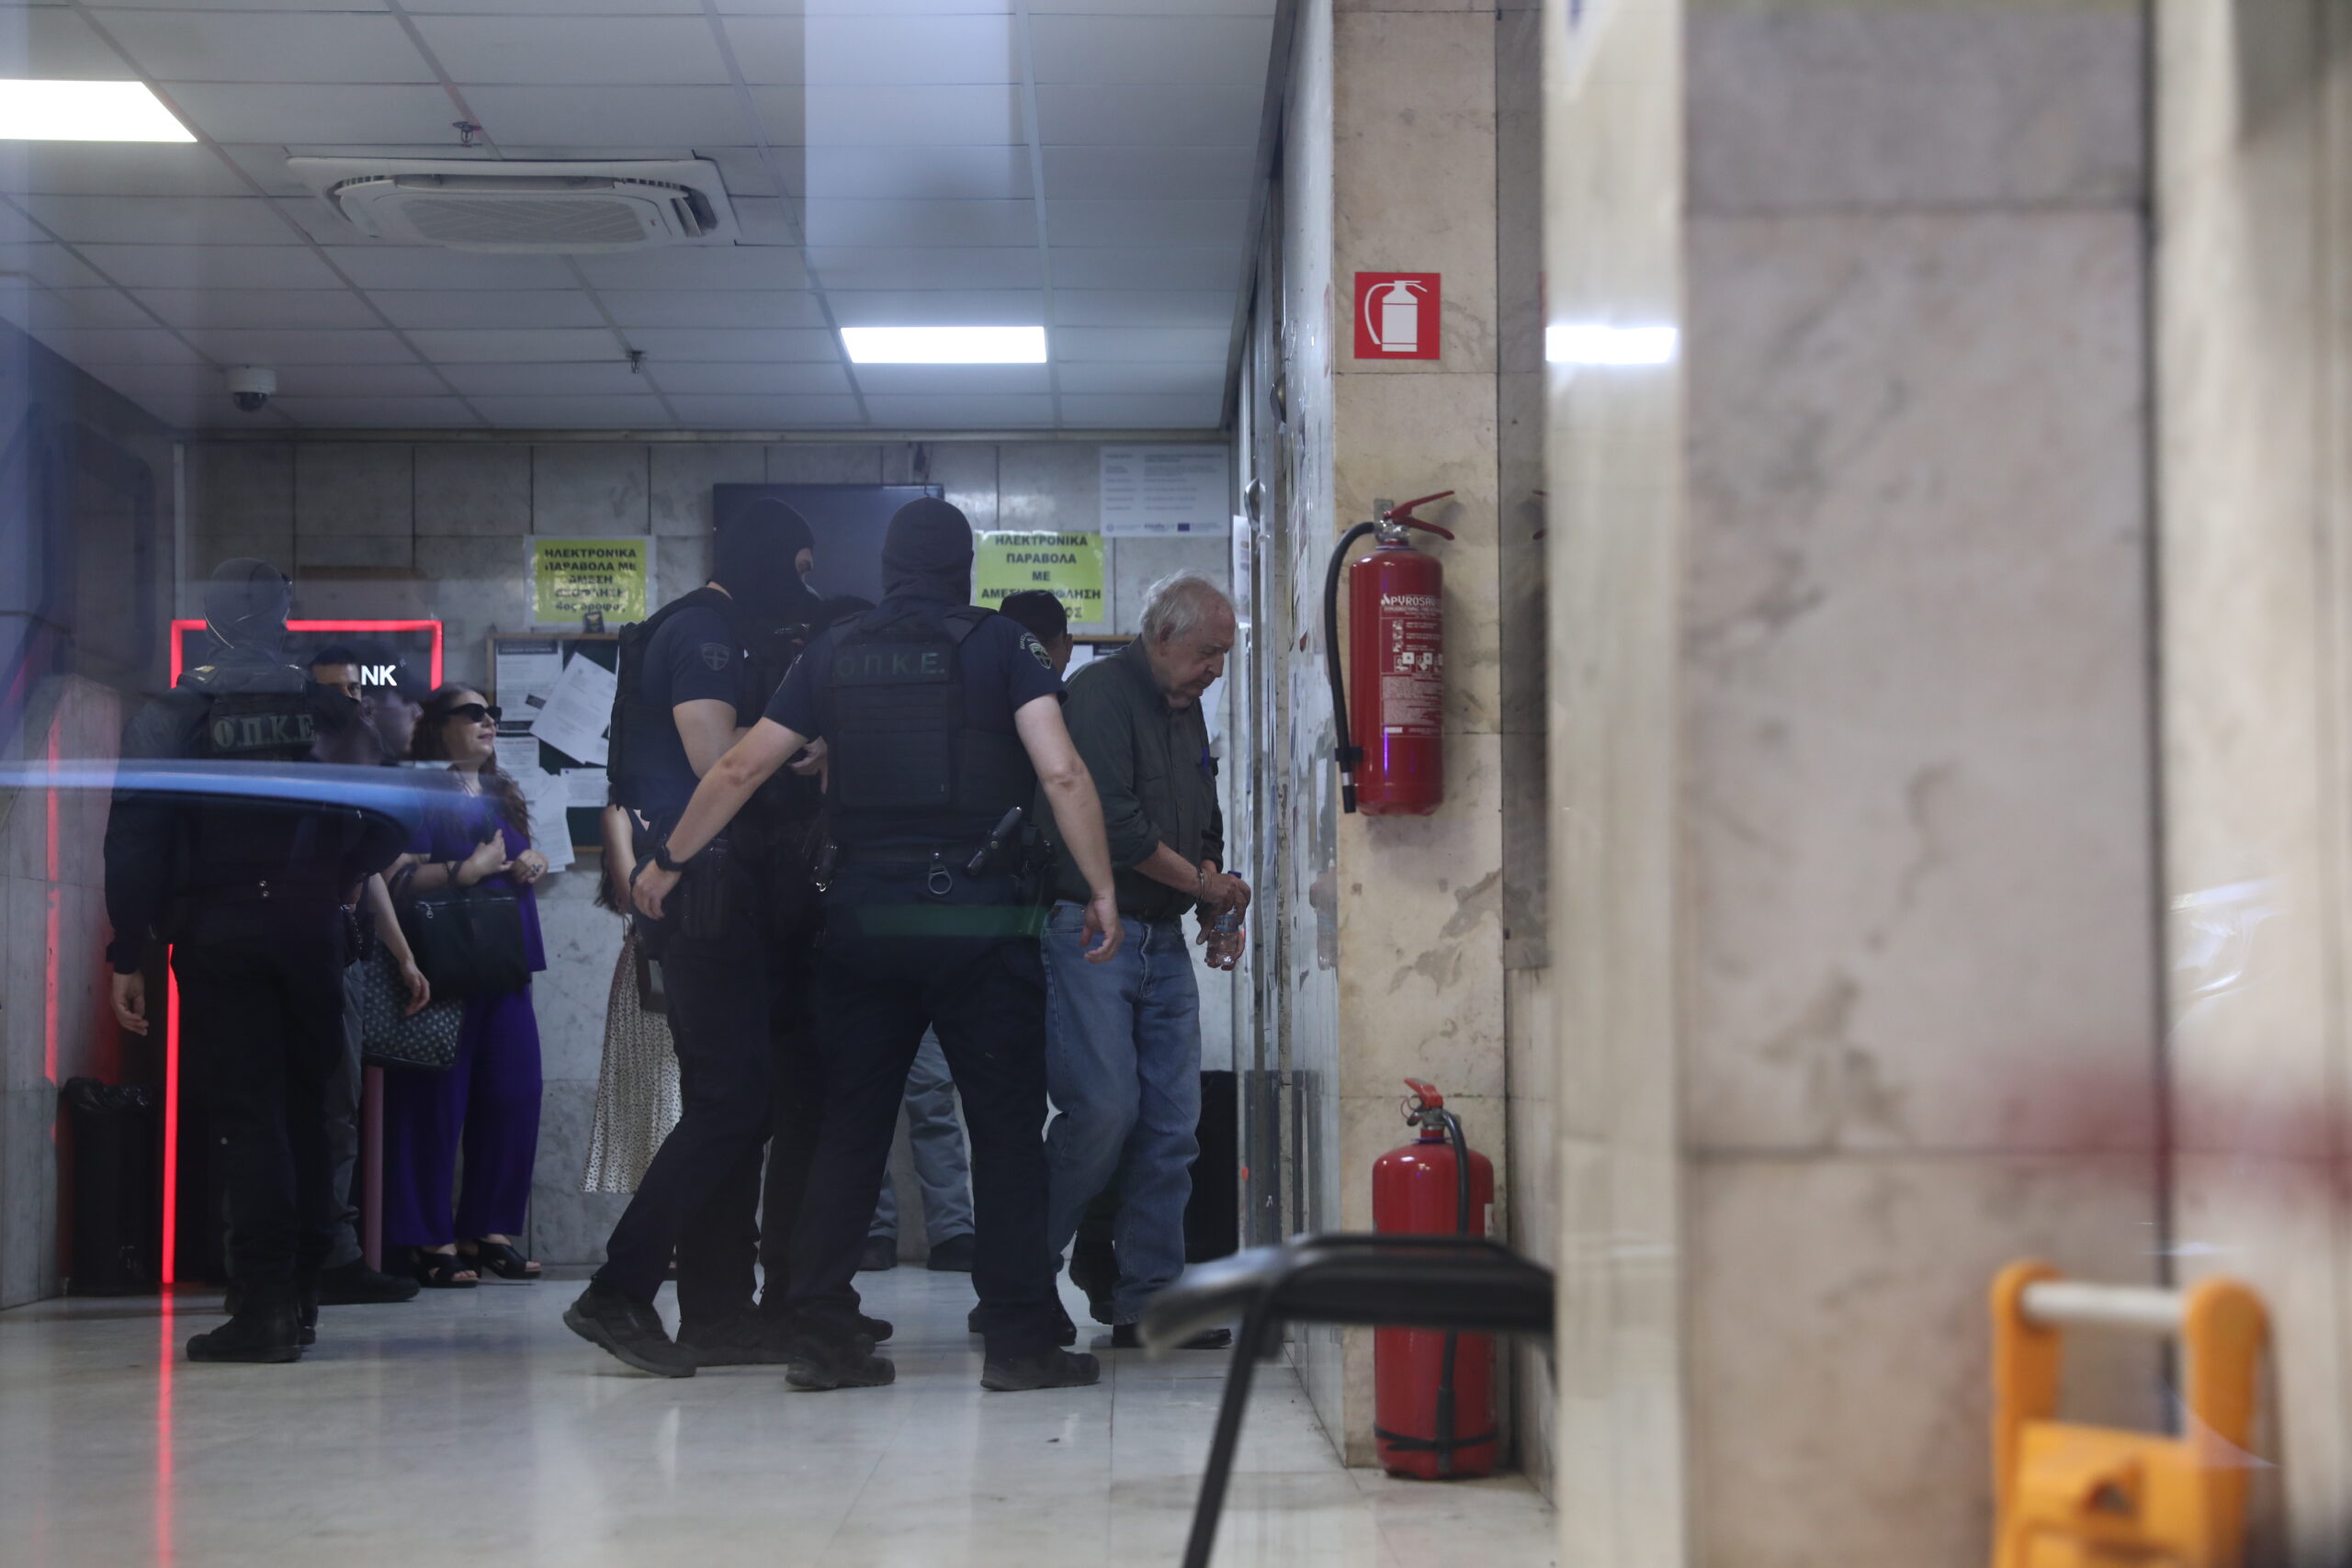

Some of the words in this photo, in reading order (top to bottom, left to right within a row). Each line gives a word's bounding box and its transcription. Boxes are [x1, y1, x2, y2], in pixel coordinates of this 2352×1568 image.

[995, 536, 1088, 547] ΗΛΕΚΤΡΟΝΙΚΑ
[545, 548, 637, 558] ΗΛΕΚΤΡΟΝΙΚΑ
[1006, 553, 1077, 564] ΠΑΡΑΒΟΛΑ
[1032, 570, 1051, 581] ΜΕ
[361, 665, 398, 686] NK
